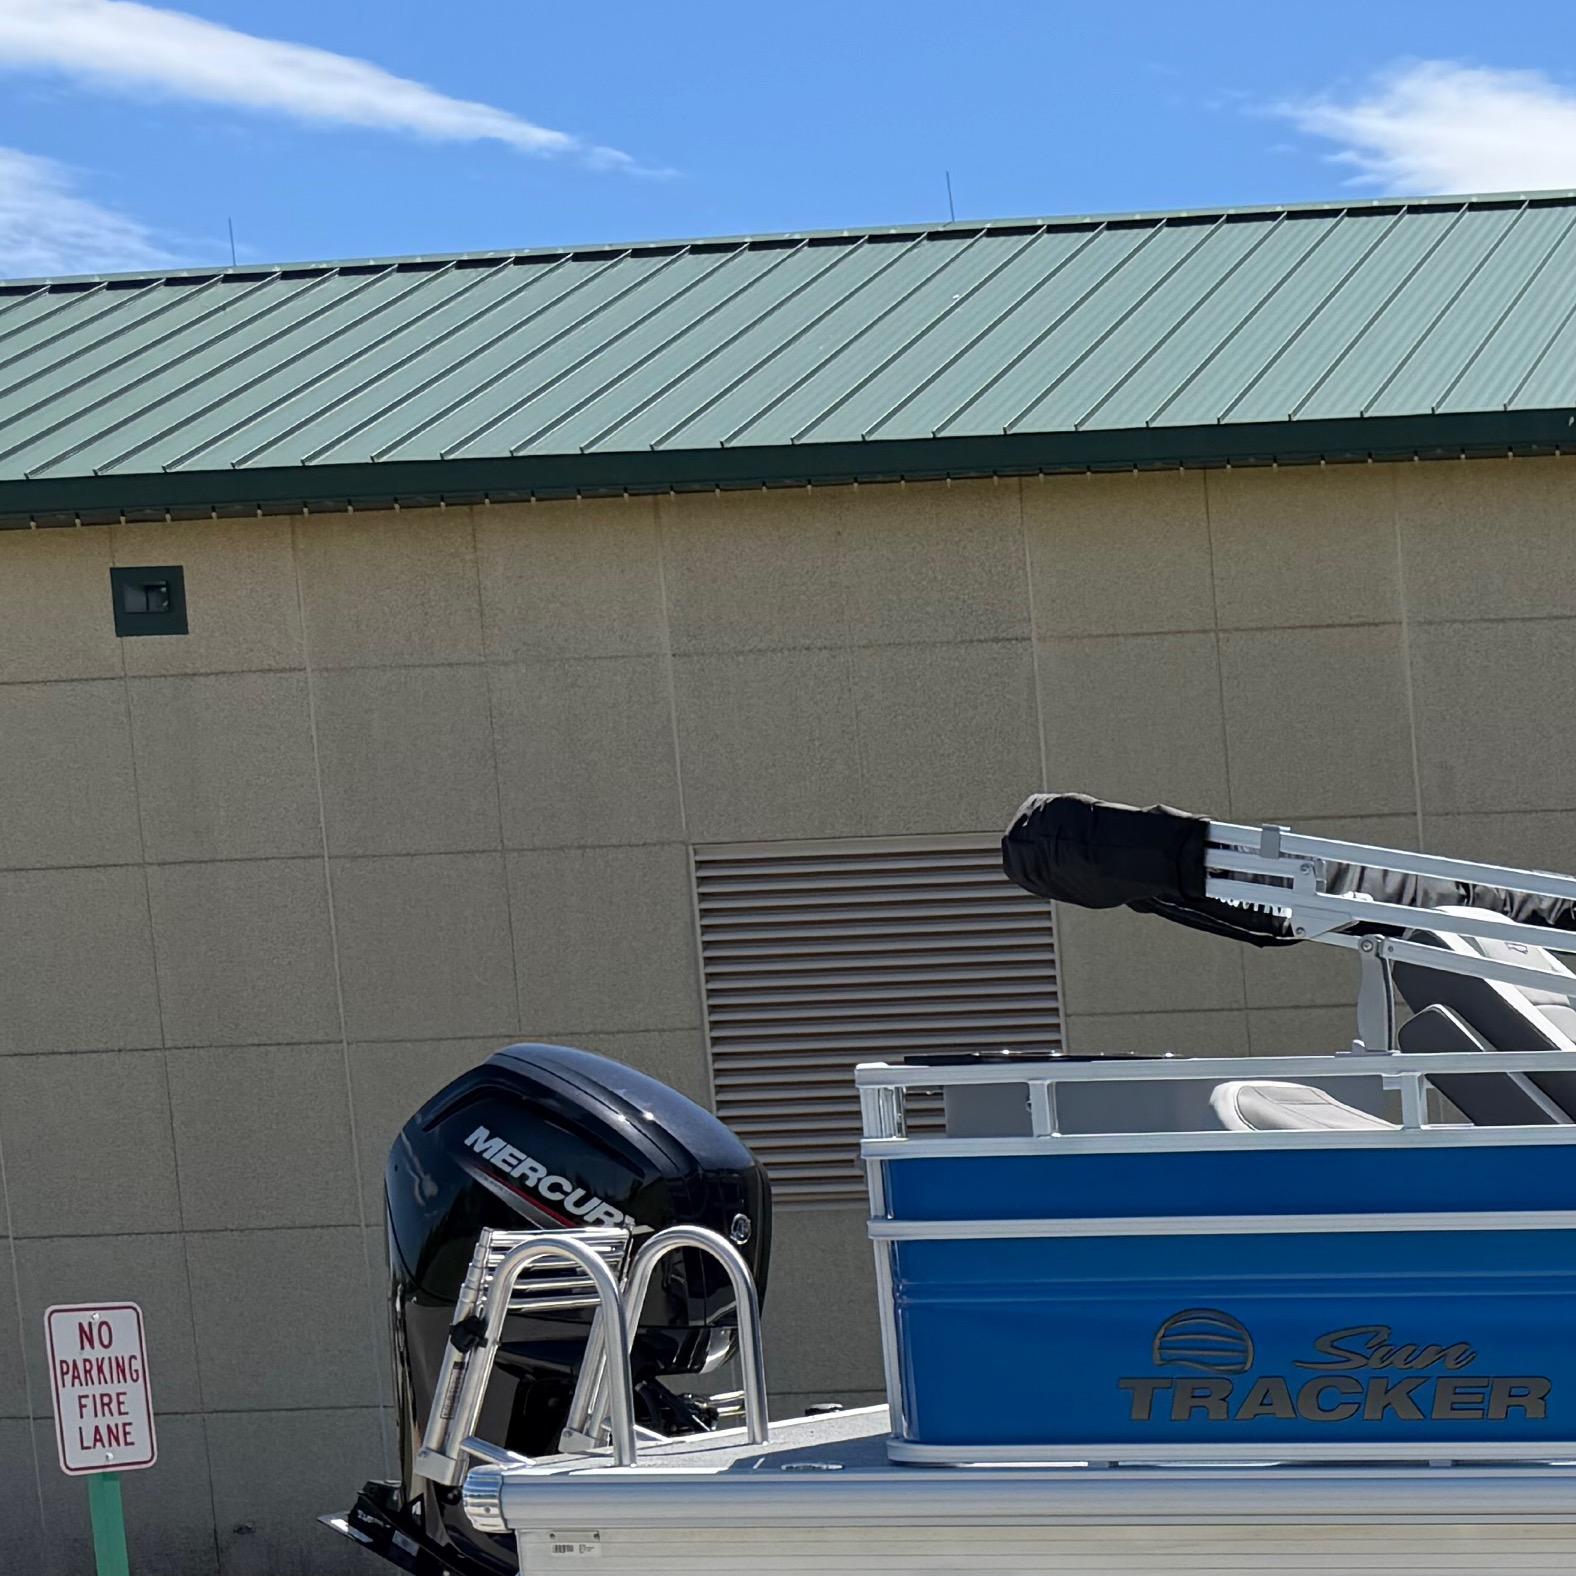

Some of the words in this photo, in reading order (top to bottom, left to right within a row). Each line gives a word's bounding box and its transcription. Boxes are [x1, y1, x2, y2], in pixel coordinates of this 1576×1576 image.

[78, 1320, 113, 1350] NO
[1293, 1324, 1478, 1371] Sun
[59, 1354, 140, 1389] PARKING
[77, 1391, 129, 1419] FIRE
[1117, 1375, 1553, 1421] TRACKER
[78, 1422, 136, 1451] LANE
